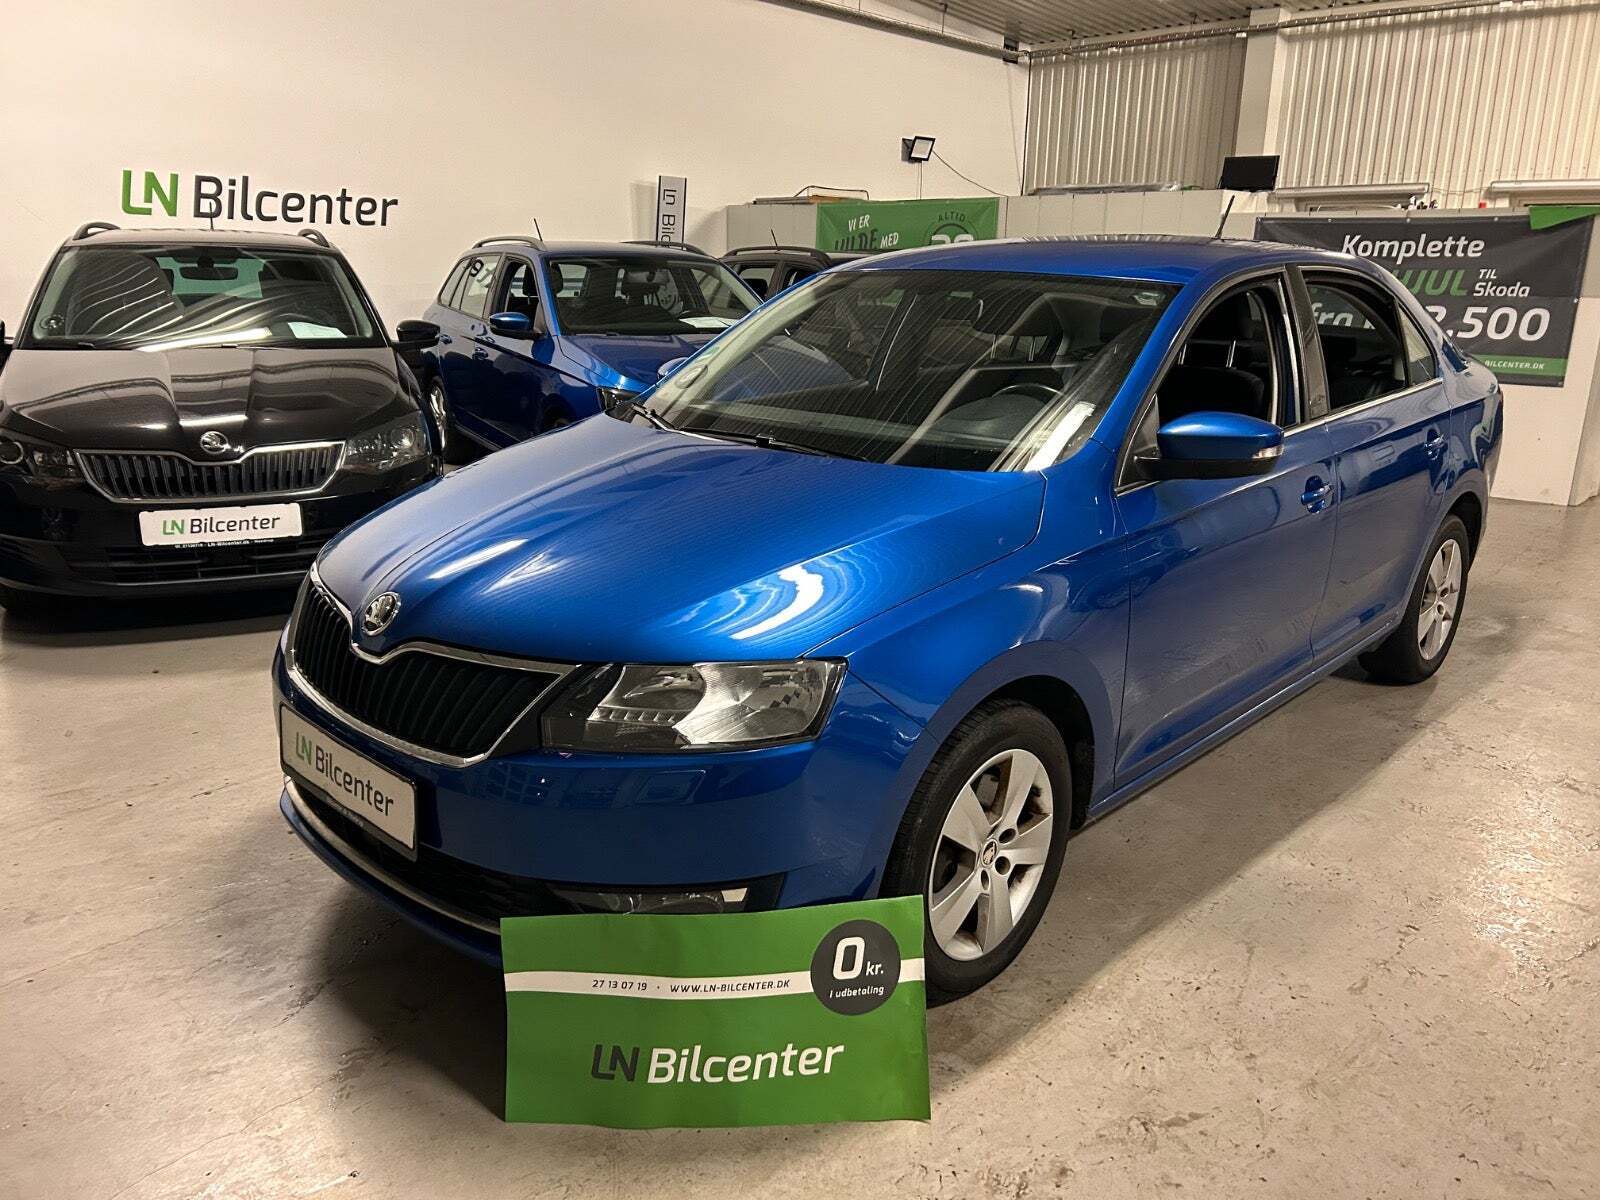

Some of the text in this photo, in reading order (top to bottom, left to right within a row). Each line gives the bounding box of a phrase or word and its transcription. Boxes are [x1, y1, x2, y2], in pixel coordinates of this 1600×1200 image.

[121, 169, 399, 227] LN Bilcenter
[848, 214, 871, 232] VI ER
[880, 232, 899, 248] MED
[1341, 233, 1485, 265] Komplette
[1479, 268, 1497, 279] TIL
[1473, 281, 1531, 298] Skoda
[162, 516, 281, 535] LN Bilcenter
[295, 731, 394, 817] LN Bilcenter
[832, 936, 884, 980] 0 kr.
[592, 979, 790, 993] 27 13 07 19 WWW.LN-BILCENTER.DK
[835, 985, 885, 998] udbetaling
[591, 1042, 845, 1084] LN Bilcenter
